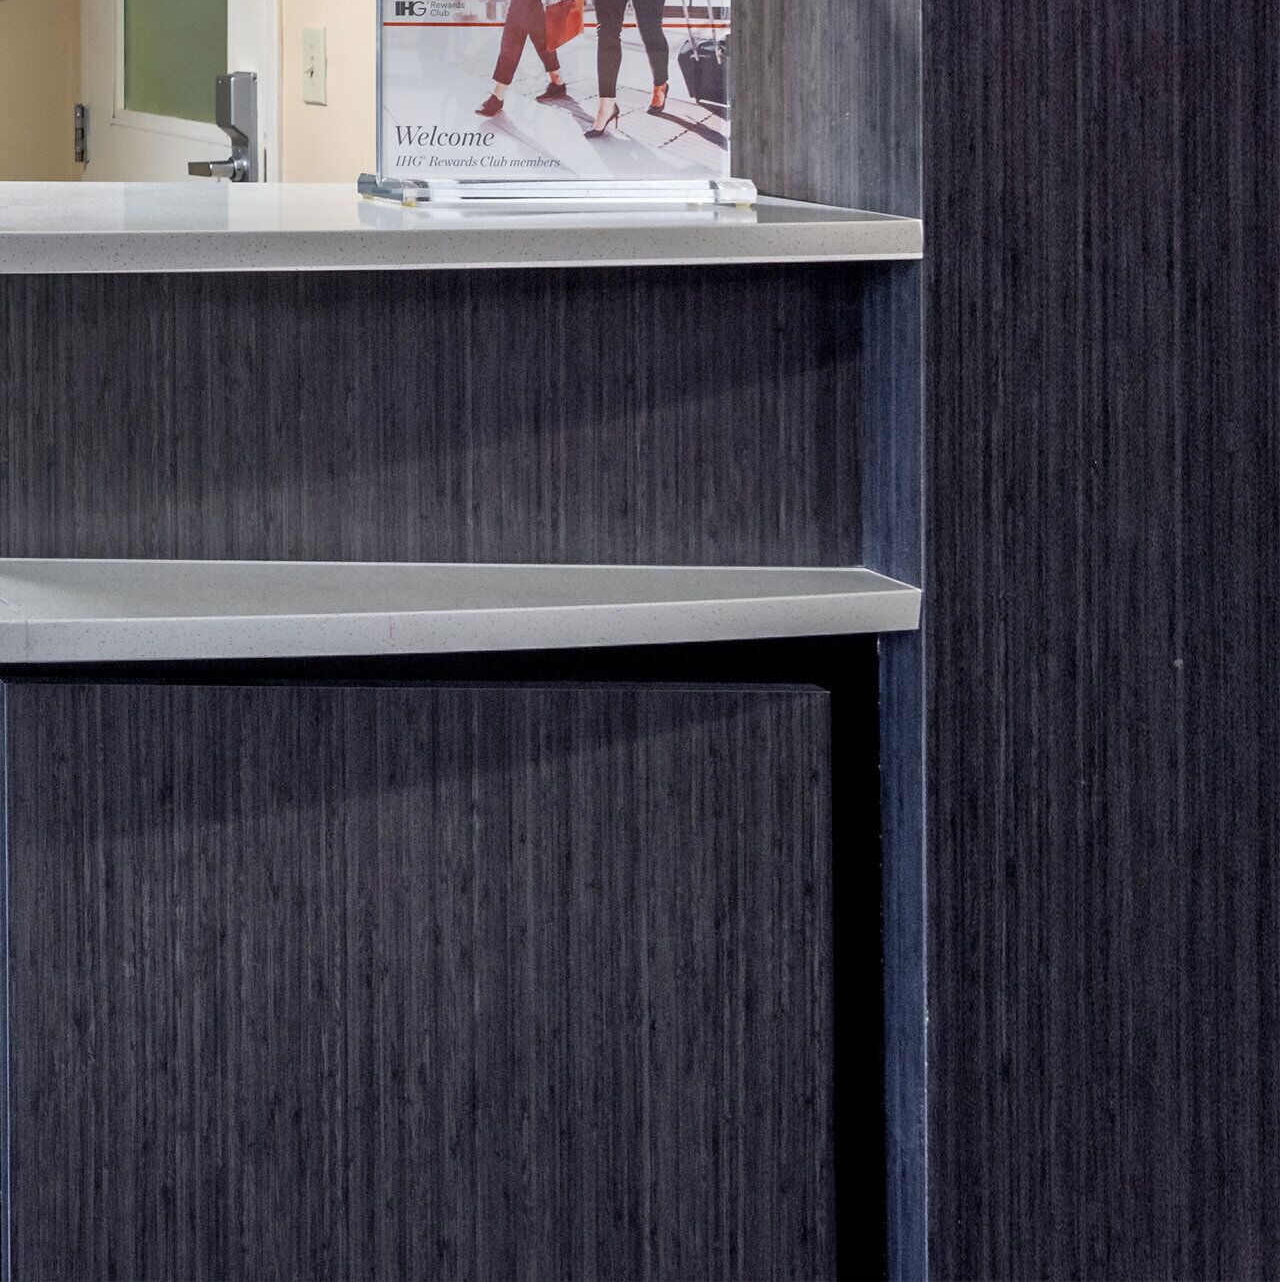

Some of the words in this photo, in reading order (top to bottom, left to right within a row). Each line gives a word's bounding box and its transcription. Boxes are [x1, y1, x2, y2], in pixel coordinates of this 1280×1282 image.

[395, 1, 427, 17] IHG
[430, 1, 465, 9] Rewards
[430, 8, 450, 17] Club
[395, 125, 495, 147] Welcome
[429, 155, 478, 168] Rewards
[479, 155, 508, 168] Club
[509, 155, 561, 168] members
